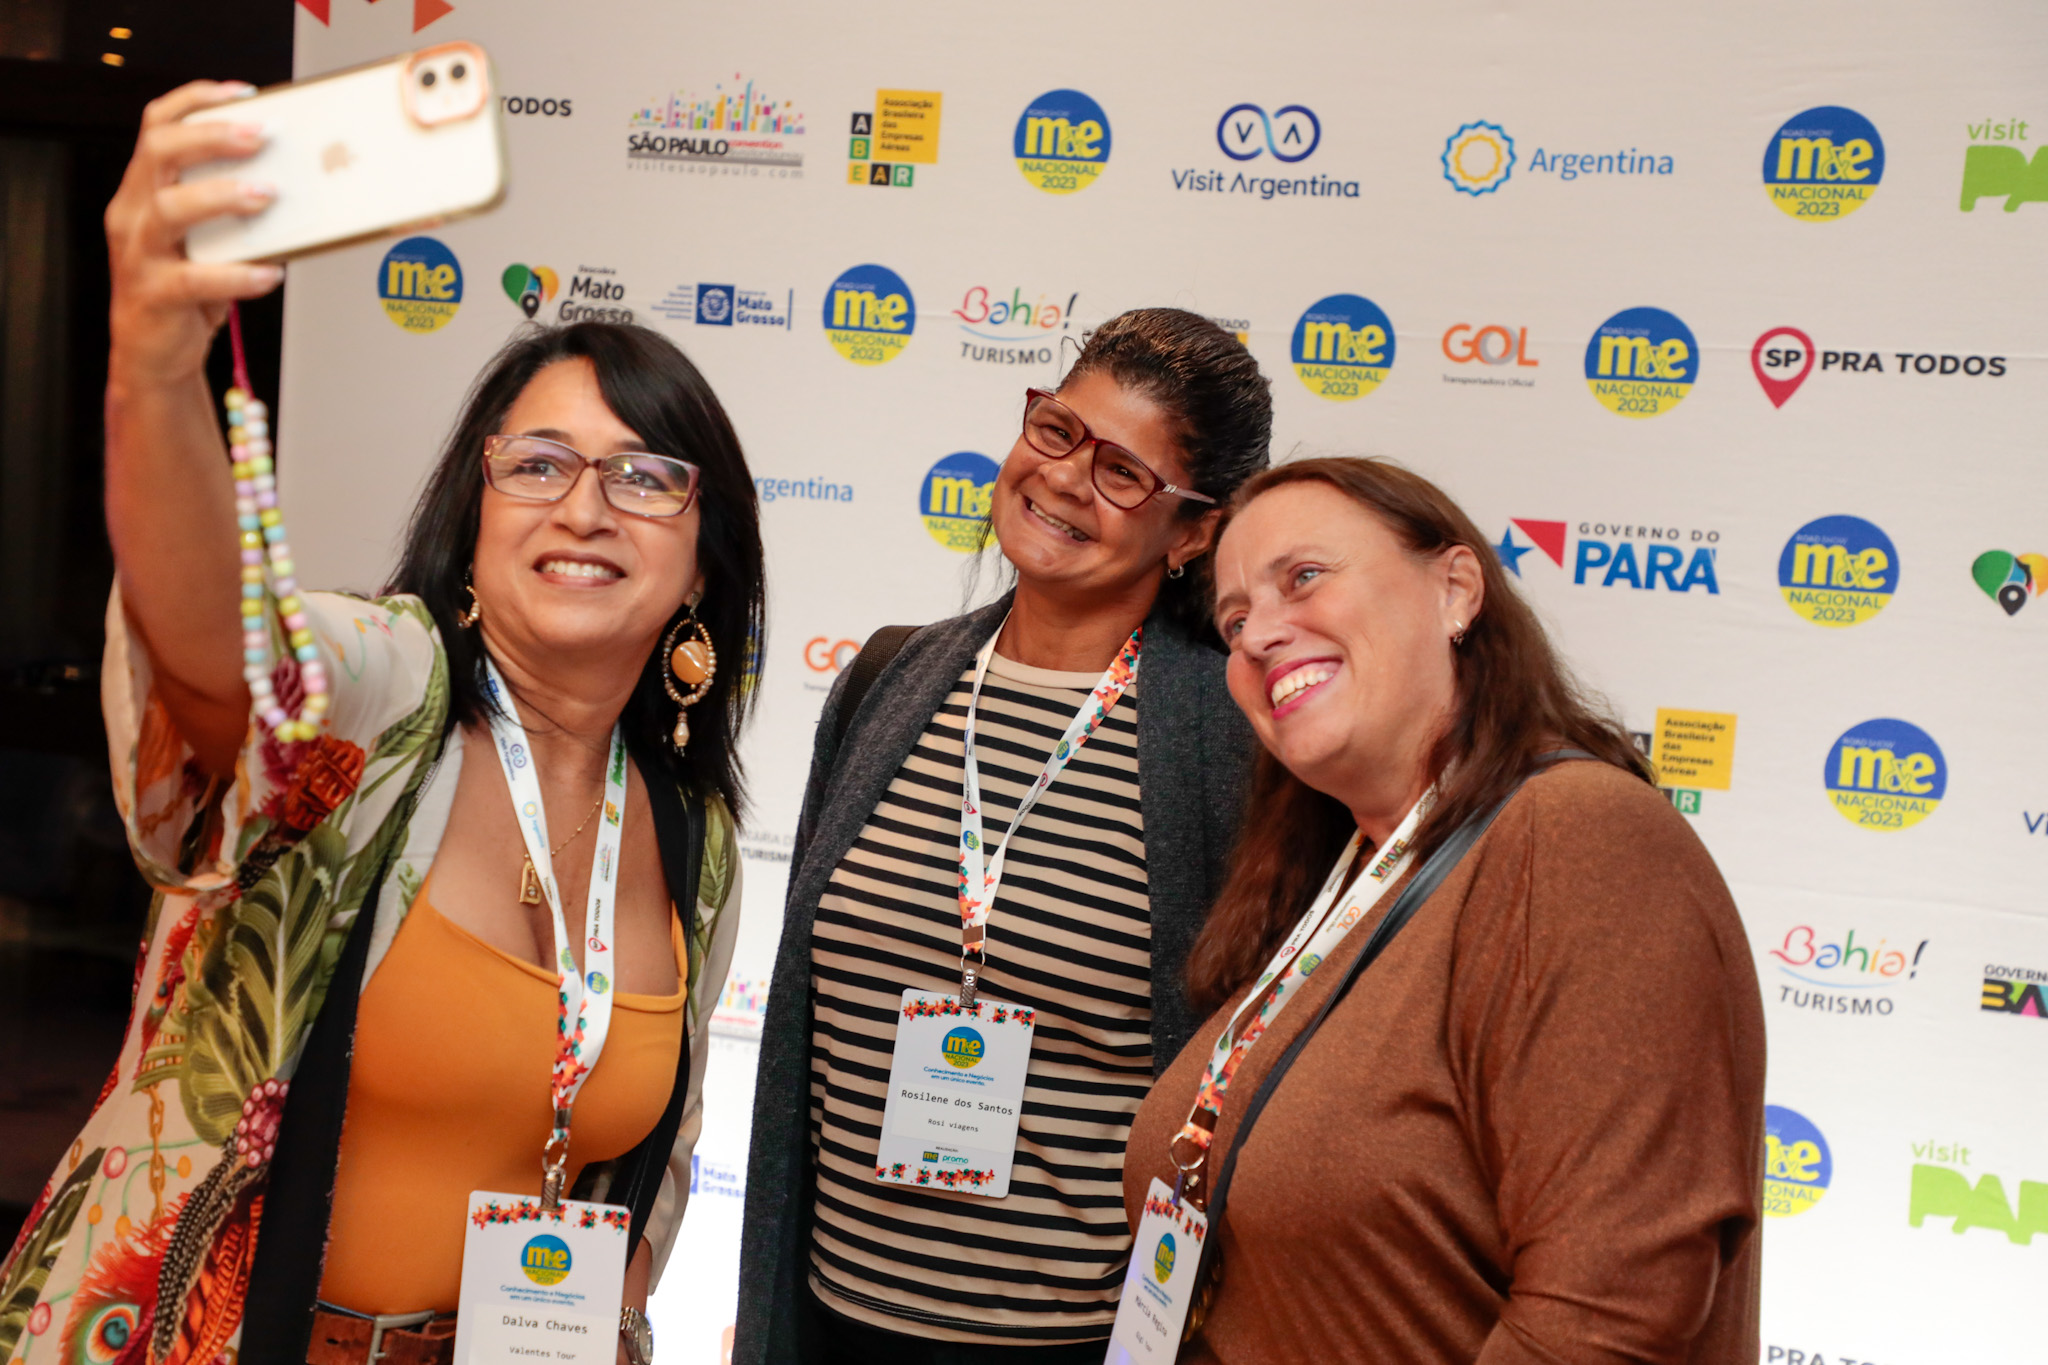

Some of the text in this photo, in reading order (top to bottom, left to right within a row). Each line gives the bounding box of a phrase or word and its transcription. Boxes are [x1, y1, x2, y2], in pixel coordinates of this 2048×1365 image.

[883, 98, 933, 109] Associação
[882, 109, 925, 120] Brasileira
[881, 120, 898, 129] das
[1966, 118, 2030, 141] visit
[628, 132, 728, 155] SÃO PAULO
[881, 131, 924, 144] Empresas
[1024, 116, 1104, 159] m&e
[880, 142, 911, 152] Aéreas
[1528, 147, 1675, 181] Argentina
[1776, 137, 1874, 181] m&e
[1023, 161, 1099, 176] NACIONAL
[1041, 175, 1077, 190] 2023
[1171, 168, 1361, 200] Visit Argentina
[1773, 186, 1868, 201] NACIONAL
[1796, 201, 1840, 216] 2023
[387, 260, 457, 300] m&e
[569, 276, 625, 301] Mato
[386, 302, 454, 317] NACIONAL
[736, 296, 773, 312] Mato
[833, 290, 909, 331] m&e
[952, 286, 1079, 330] Bahia!
[403, 314, 436, 329] 2023
[559, 301, 634, 326] Grosso
[736, 311, 786, 327] Grosso
[831, 332, 905, 348] NACIONAL
[1302, 321, 1387, 364] m&e
[1441, 323, 1540, 367] GOL
[850, 346, 885, 361] 2023
[961, 341, 1052, 364] TURISMO
[1597, 335, 1690, 380] m&e
[1765, 348, 2008, 377] SP PRA TODOS
[1301, 366, 1382, 383] NACIONAL
[1507, 376, 1536, 388] Oficial
[1321, 381, 1359, 396] 2023
[1595, 383, 1684, 399] NACIONAL
[1617, 397, 1659, 414] 2023
[754, 476, 854, 503] rgentina
[1579, 522, 1721, 543] GOVERNO DO
[1573, 539, 1721, 595] PARÁ
[1792, 543, 1889, 589] m&e
[1790, 590, 1884, 610] NACIONAL
[1812, 606, 1857, 624] 2023
[803, 636, 863, 674] GO
[1665, 718, 1726, 732] Associação
[1664, 730, 1716, 743] Brasileira
[1663, 742, 1682, 751] das
[1662, 753, 1714, 766] Empresas
[1838, 746, 1936, 795] m&e
[1836, 794, 1931, 814] NACIONAL
[1858, 809, 1904, 828] 2023
[741, 846, 792, 863] TURISM
[1300, 910, 1315, 933] TODOS
[1337, 906, 1361, 931] GOL
[1769, 925, 1930, 980] Bahia!
[1779, 984, 1895, 1016] TURISMO
[945, 1054, 978, 1063] NACIONAL
[953, 1060, 969, 1068] 2023
[923, 1066, 963, 1077] Conhecimento
[969, 1072, 994, 1082] Negócios
[901, 1089, 1013, 1116] Rosilene dos Santos
[927, 1118, 979, 1133] Rosi viagens
[942, 1155, 969, 1164] promo
[1911, 1139, 1972, 1166] visit
[502, 1315, 588, 1335] Dalva Chaves
[509, 1345, 576, 1361] Valentes Tour
